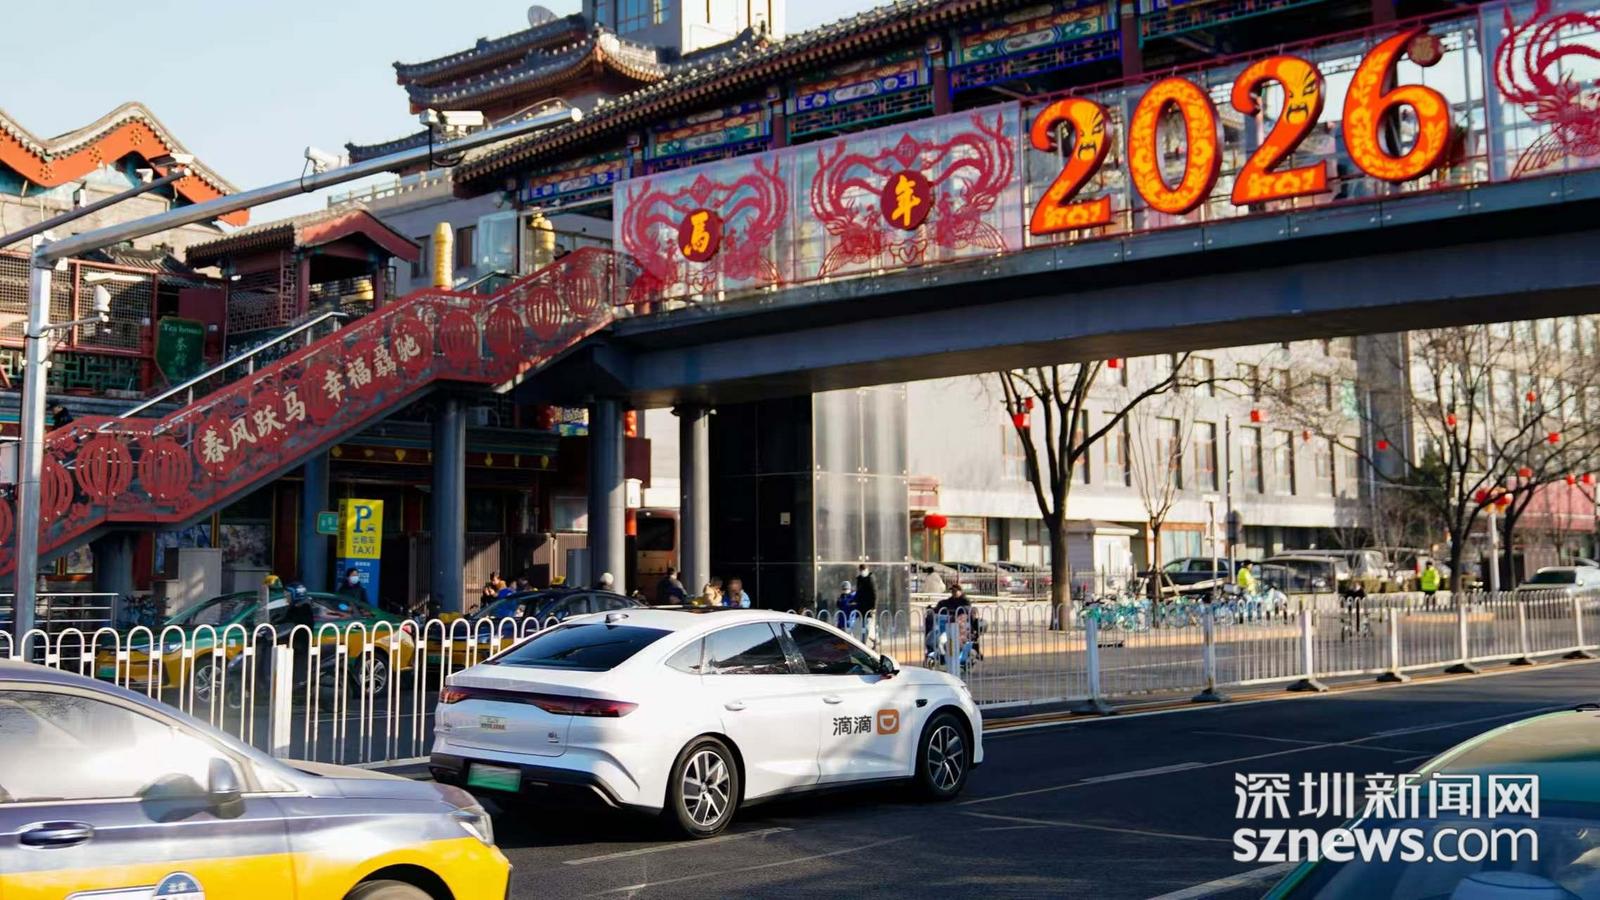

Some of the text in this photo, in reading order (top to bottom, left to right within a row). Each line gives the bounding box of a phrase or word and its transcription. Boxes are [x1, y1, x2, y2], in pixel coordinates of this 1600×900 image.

[1029, 25, 1451, 236] 2026
[891, 174, 921, 226] 年
[202, 391, 306, 464] 春风跃马
[322, 334, 421, 402] 幸福骉驰
[352, 545, 375, 554] TAXI
[832, 715, 872, 736] 滴滴
